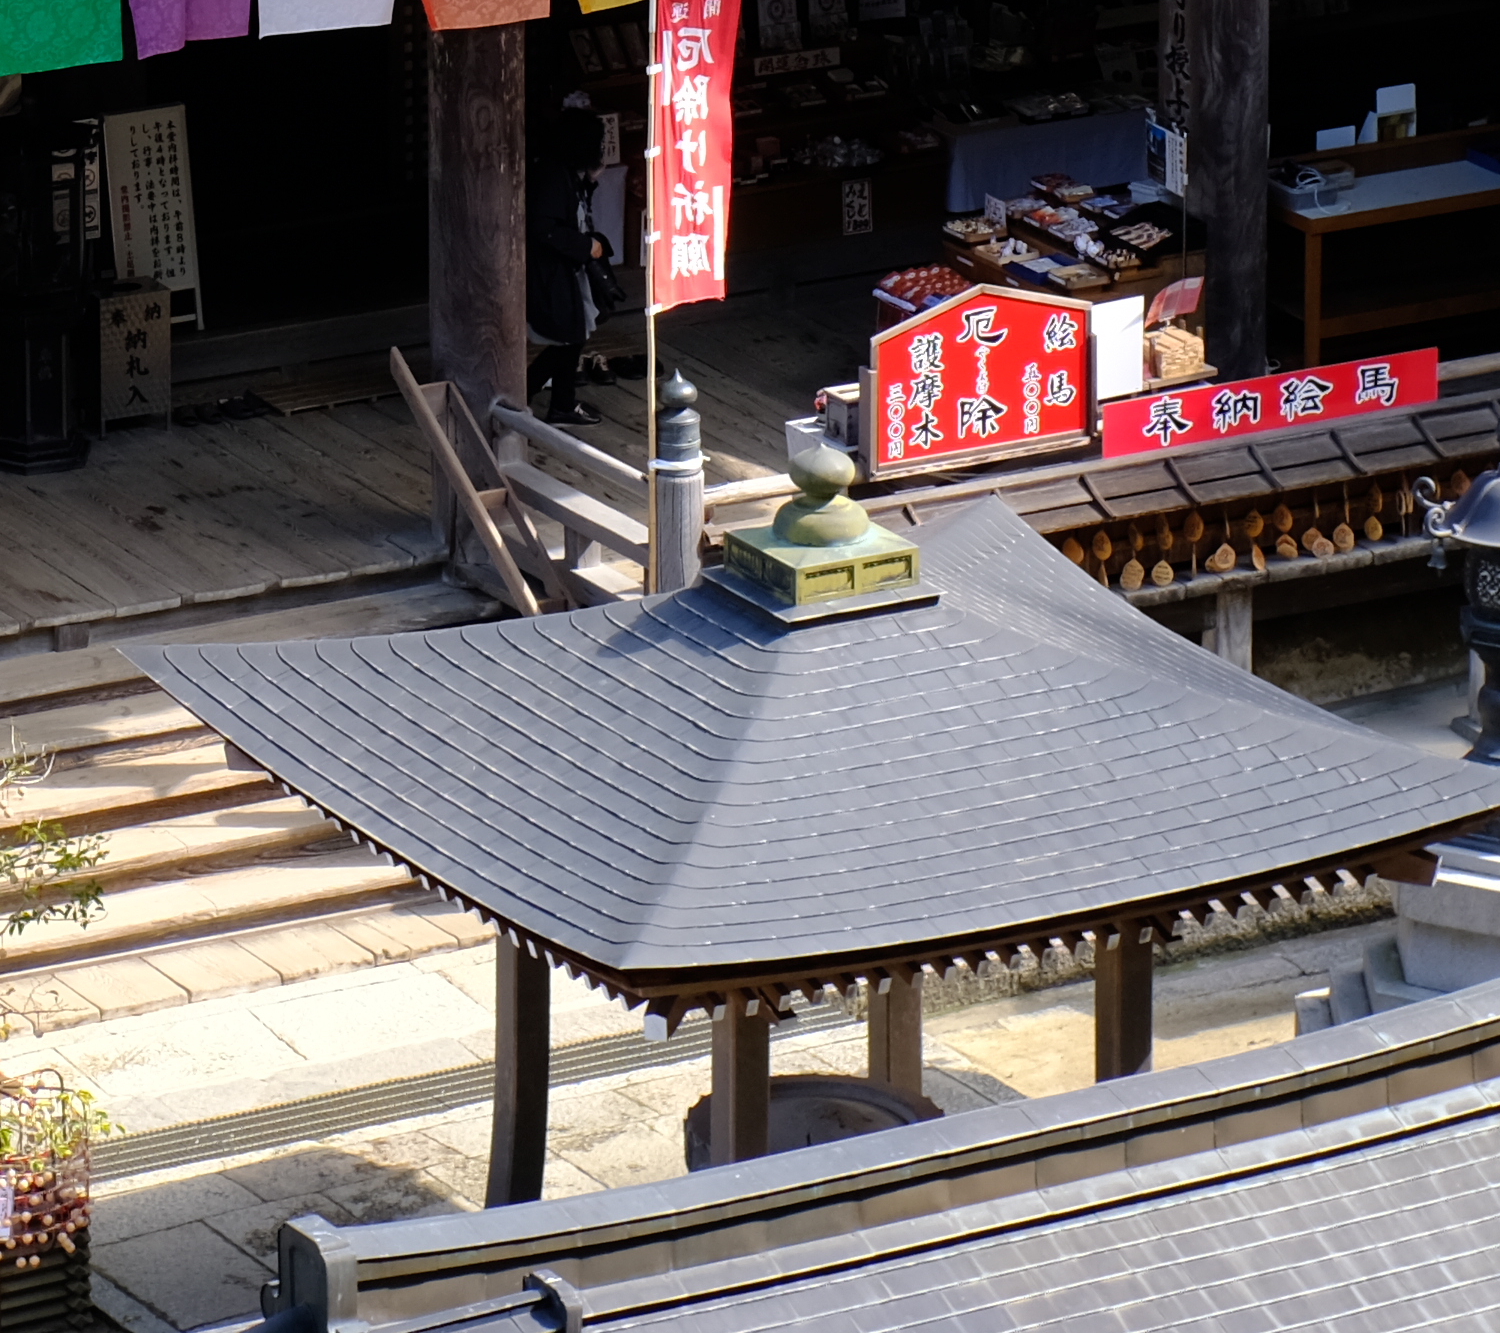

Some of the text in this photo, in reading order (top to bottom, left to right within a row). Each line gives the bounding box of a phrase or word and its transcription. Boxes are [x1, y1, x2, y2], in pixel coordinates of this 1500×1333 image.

[125, 328, 149, 407] 納札入
[908, 332, 944, 449] 護摩木
[1043, 312, 1077, 406] 絵馬
[1142, 362, 1399, 447] 奉納絵馬
